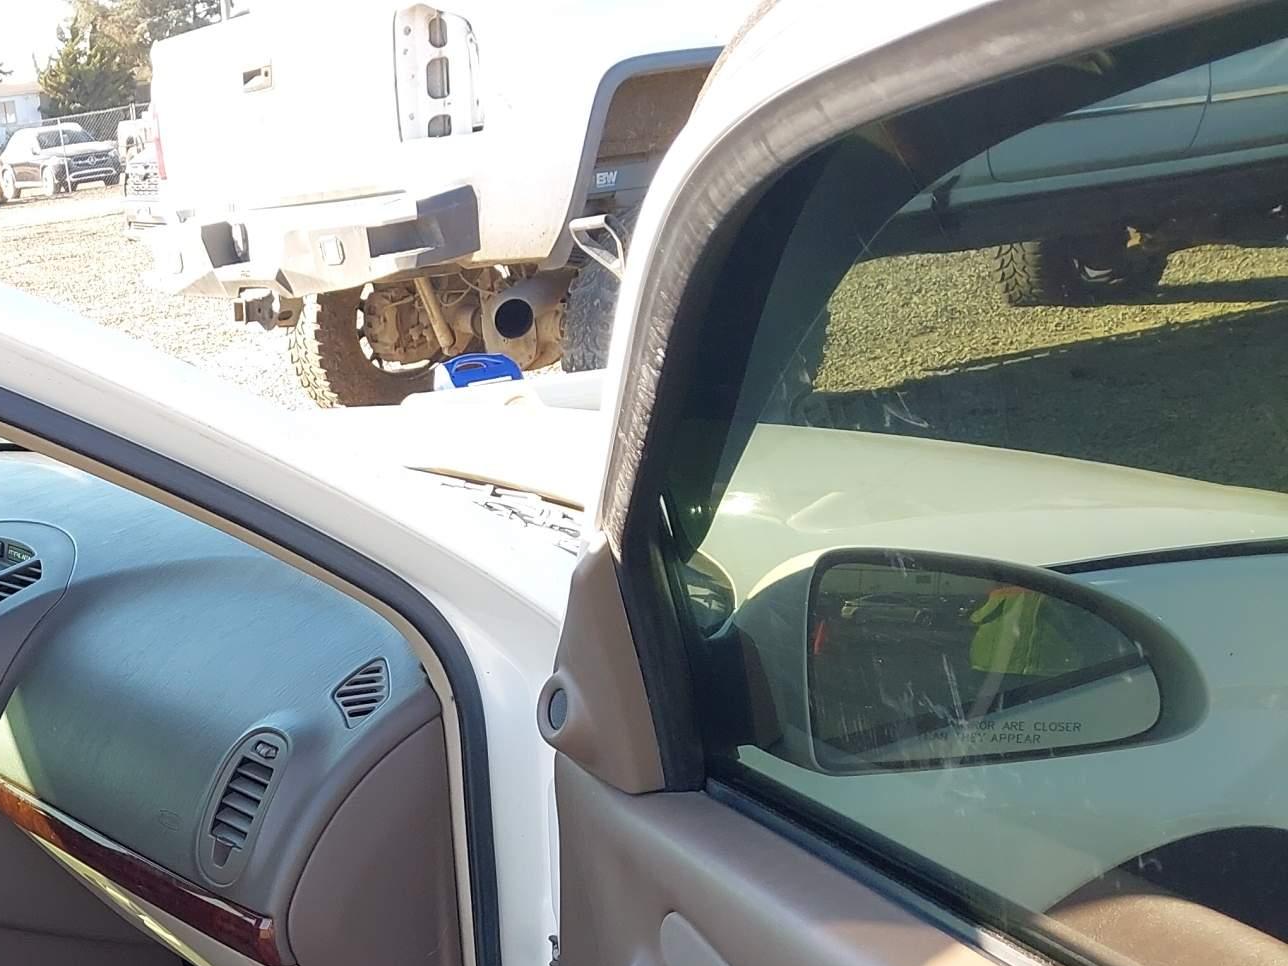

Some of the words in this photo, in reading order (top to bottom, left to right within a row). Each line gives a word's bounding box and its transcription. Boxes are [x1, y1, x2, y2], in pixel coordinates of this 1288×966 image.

[1001, 721, 1025, 731] ARE
[1033, 721, 1082, 732] CLOSER
[991, 733, 1041, 744] APPEAR
